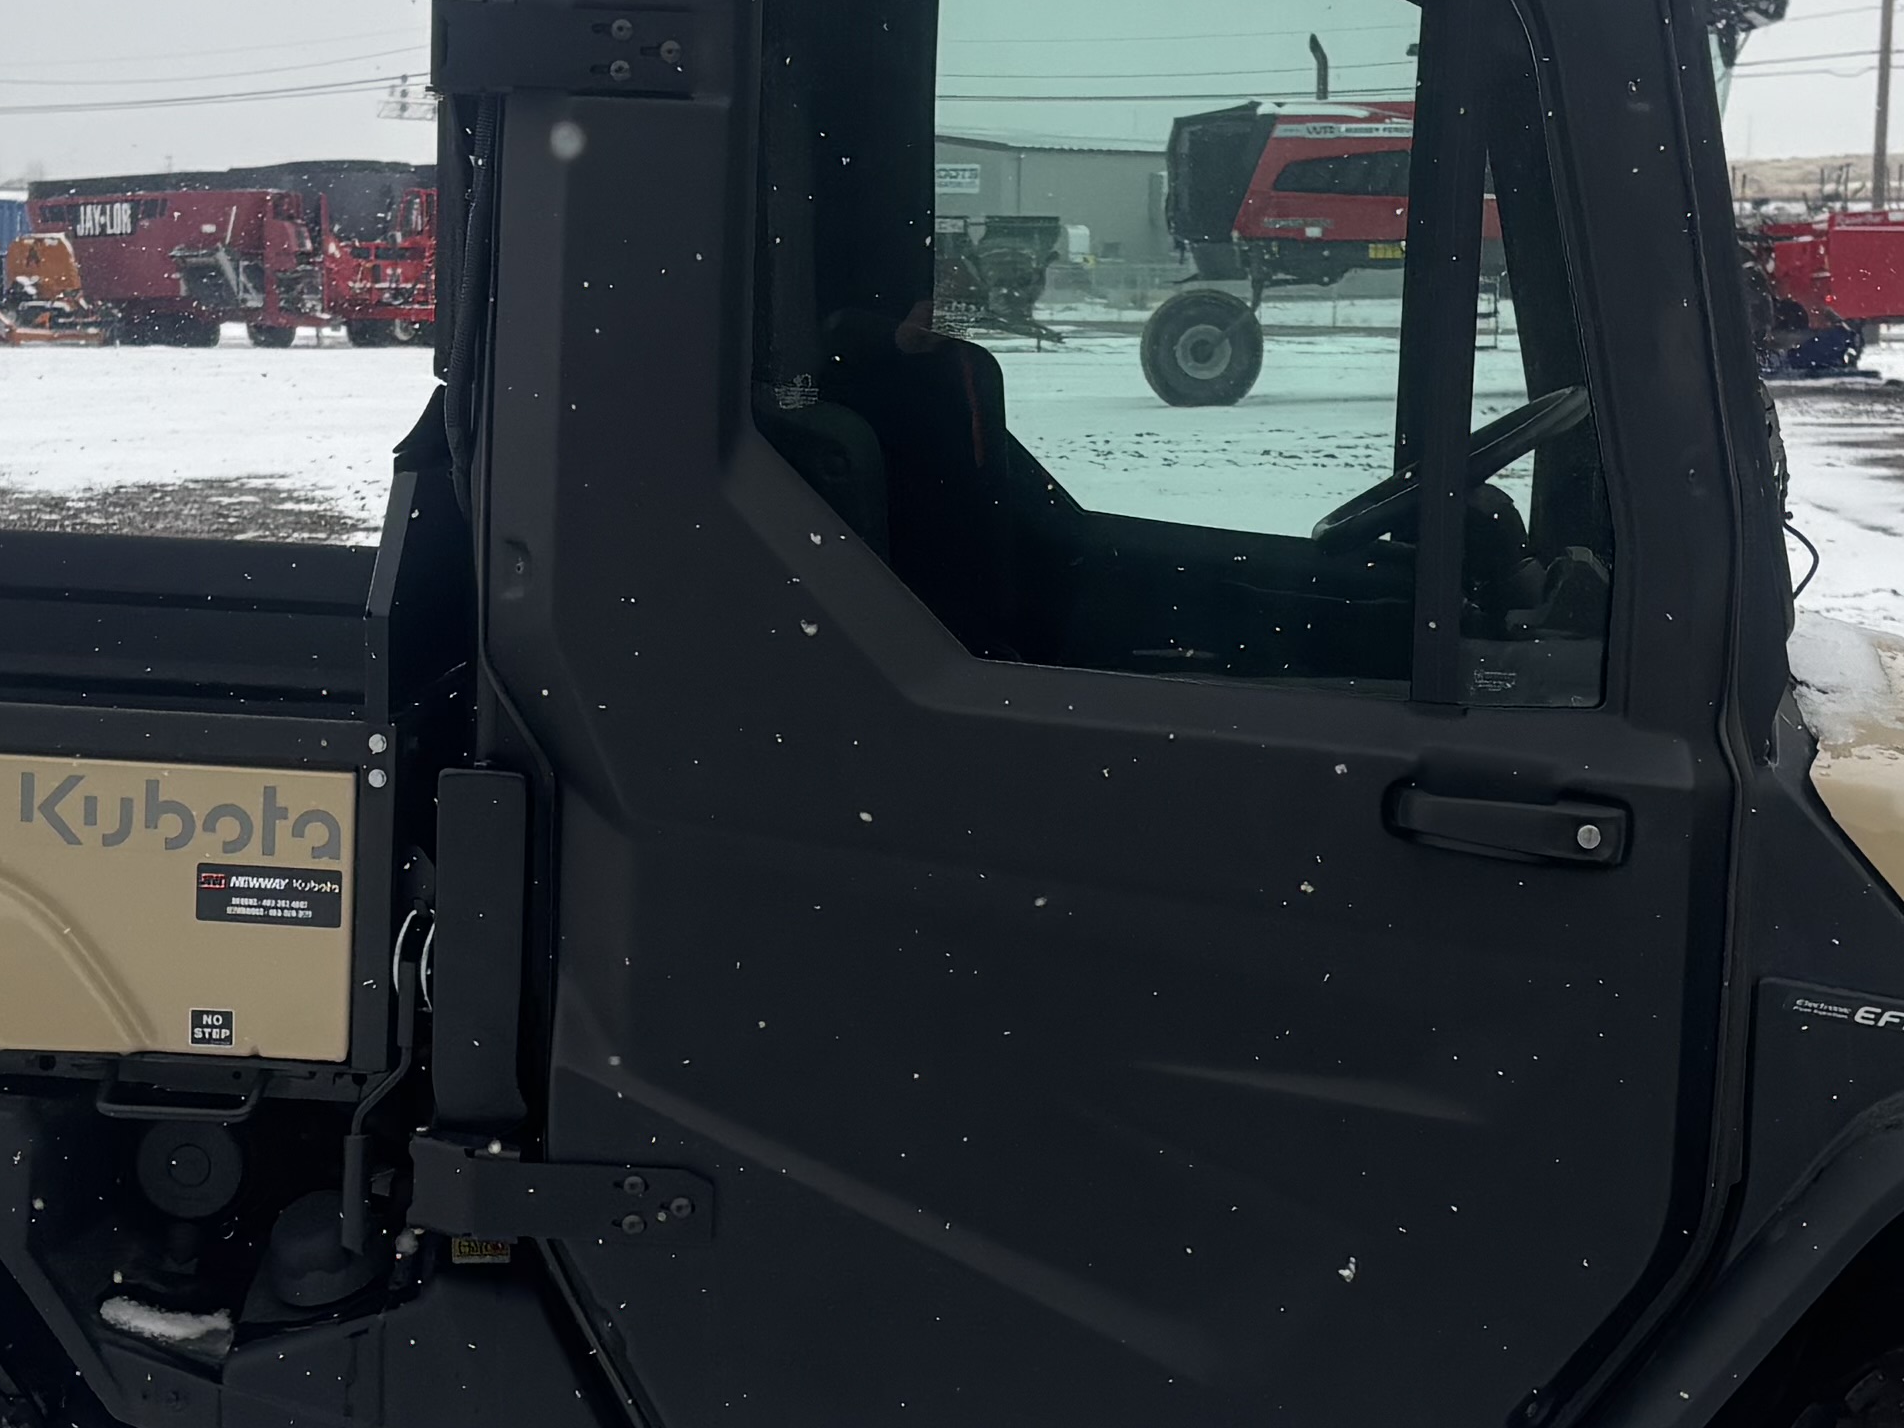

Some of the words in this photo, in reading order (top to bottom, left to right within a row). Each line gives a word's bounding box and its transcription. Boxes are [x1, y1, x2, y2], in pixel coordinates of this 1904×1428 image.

[20, 771, 342, 861] Kubota
[292, 879, 340, 893] Kubota
[202, 1013, 223, 1026] NO
